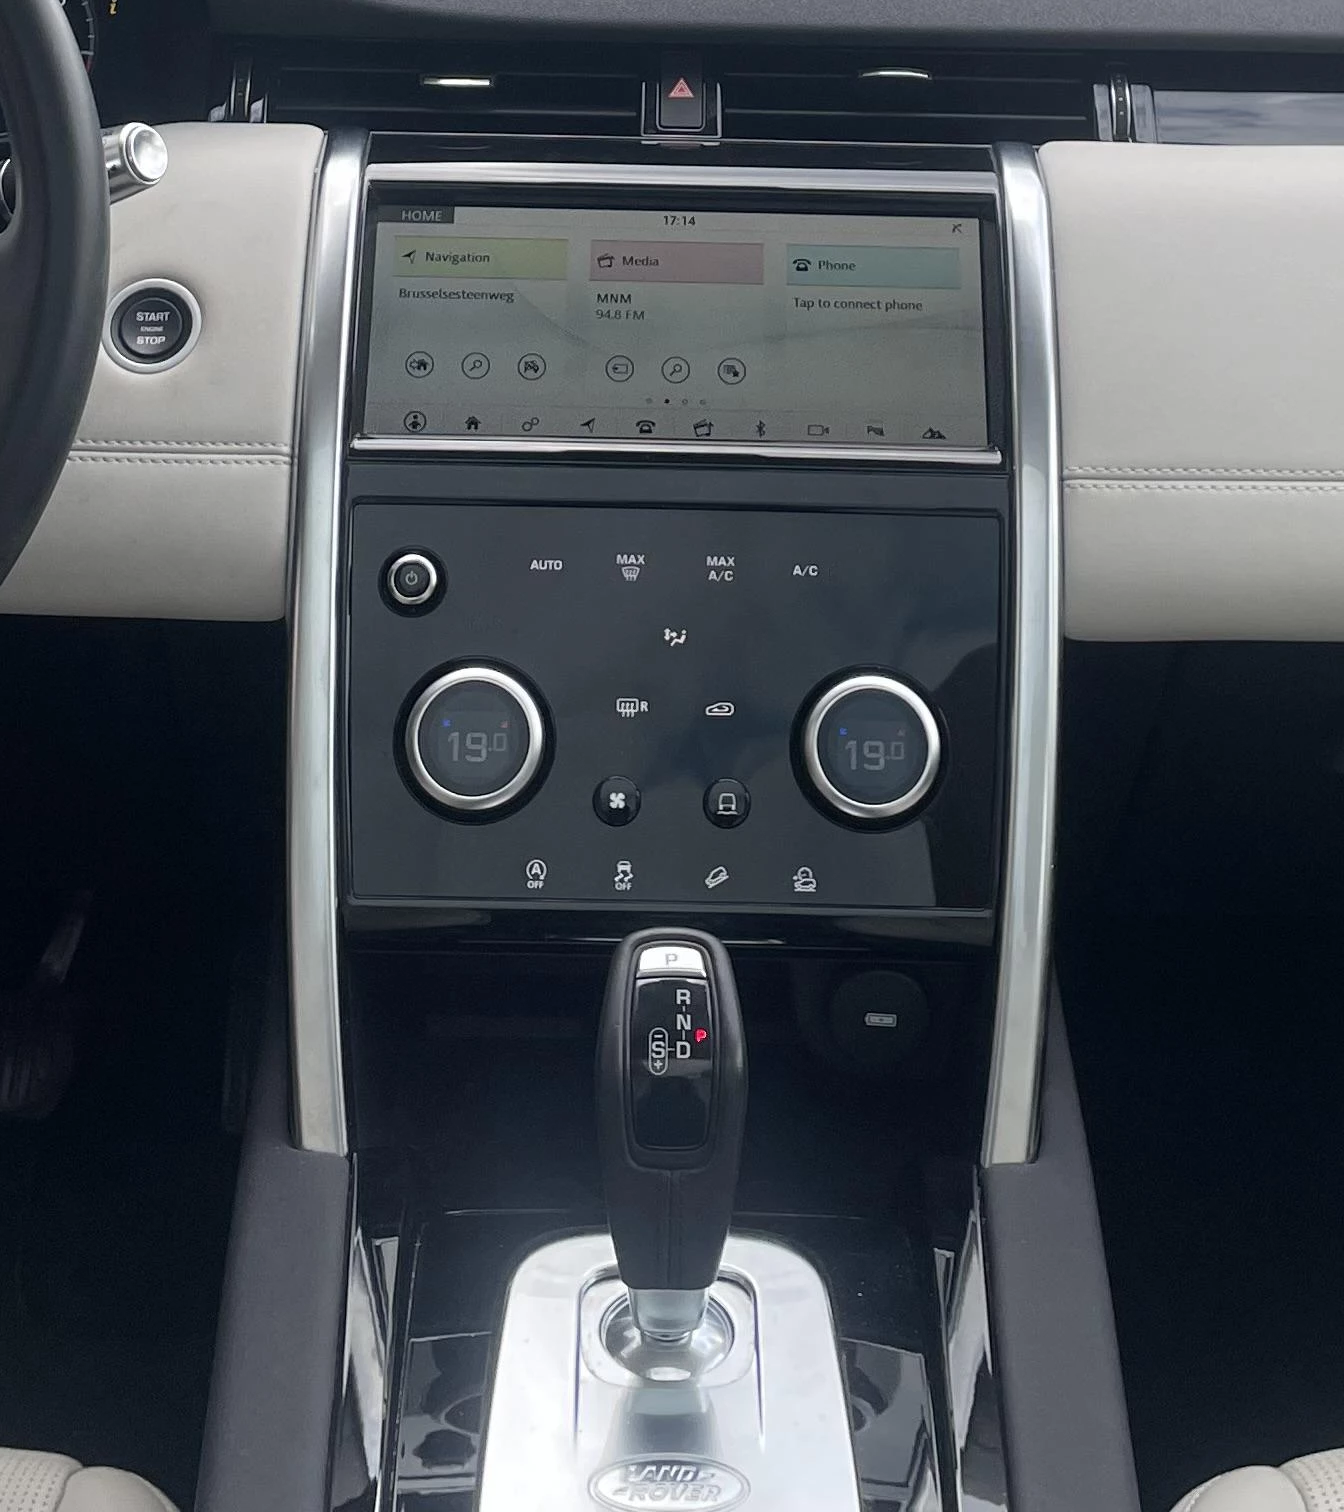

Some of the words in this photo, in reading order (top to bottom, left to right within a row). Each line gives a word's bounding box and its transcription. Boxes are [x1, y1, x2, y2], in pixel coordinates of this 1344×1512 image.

[401, 210, 442, 222] HOME
[663, 215, 696, 226] 17:14
[425, 251, 490, 265] Navigation
[622, 256, 659, 266] Media
[818, 260, 856, 271] Phone
[399, 288, 515, 303] Brusselsesteenweg
[597, 293, 632, 304] MNM
[793, 297, 814, 309] Tap
[819, 299, 830, 309] to
[834, 300, 882, 310] connect
[885, 300, 923, 312] phone
[136, 311, 170, 322] START
[596, 309, 622, 320] 94.8
[625, 310, 645, 320] FM
[136, 336, 166, 345] STOP
[530, 559, 563, 571] AUTO
[616, 554, 645, 565] MAX
[706, 556, 735, 567] MAX
[708, 570, 734, 582] A/C
[792, 564, 818, 577] A/C
[640, 700, 649, 712] R
[447, 731, 507, 762] 19.0
[845, 740, 905, 770] 19.0
[527, 880, 544, 889] OFF
[615, 882, 632, 891] OFF
[664, 952, 678, 966] P
[676, 989, 691, 1005] R
[676, 1014, 691, 1030] N
[651, 1042, 666, 1059] S
[676, 1042, 691, 1059] D
[626, 1465, 698, 1482] LAND
[628, 1483, 722, 1502] ROVER
